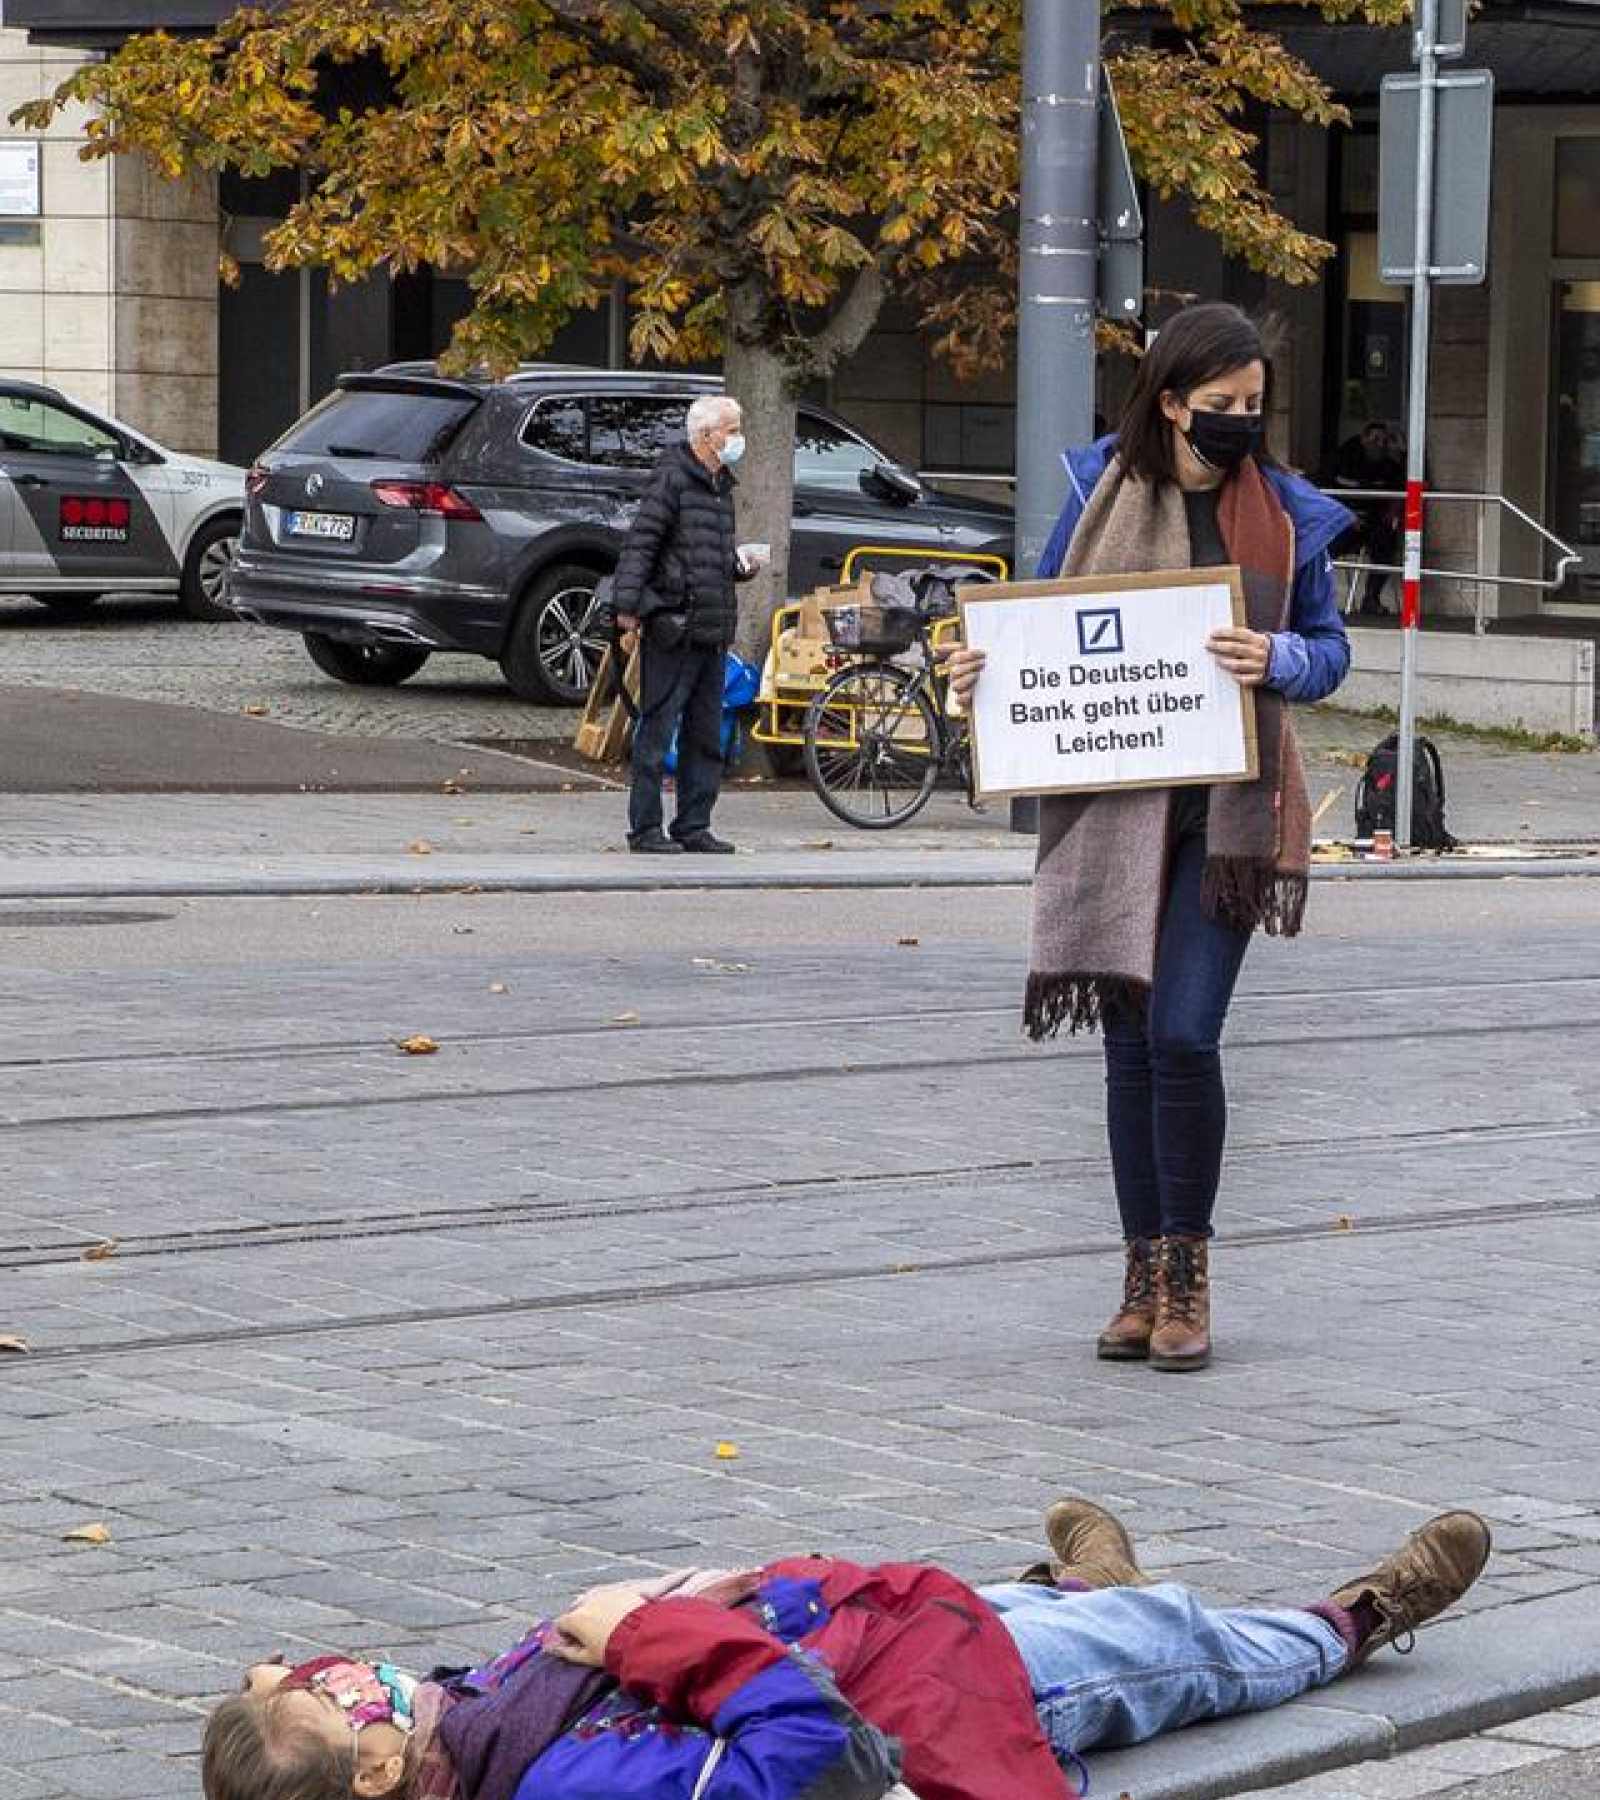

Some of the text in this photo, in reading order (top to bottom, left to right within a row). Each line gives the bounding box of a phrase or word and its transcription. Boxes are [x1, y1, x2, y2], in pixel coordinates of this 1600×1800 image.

[62, 526, 127, 541] SECURITAS
[1019, 659, 1188, 690] Die Deutsche
[1010, 693, 1204, 724] Bank geht über
[1055, 727, 1165, 755] Leichen!
